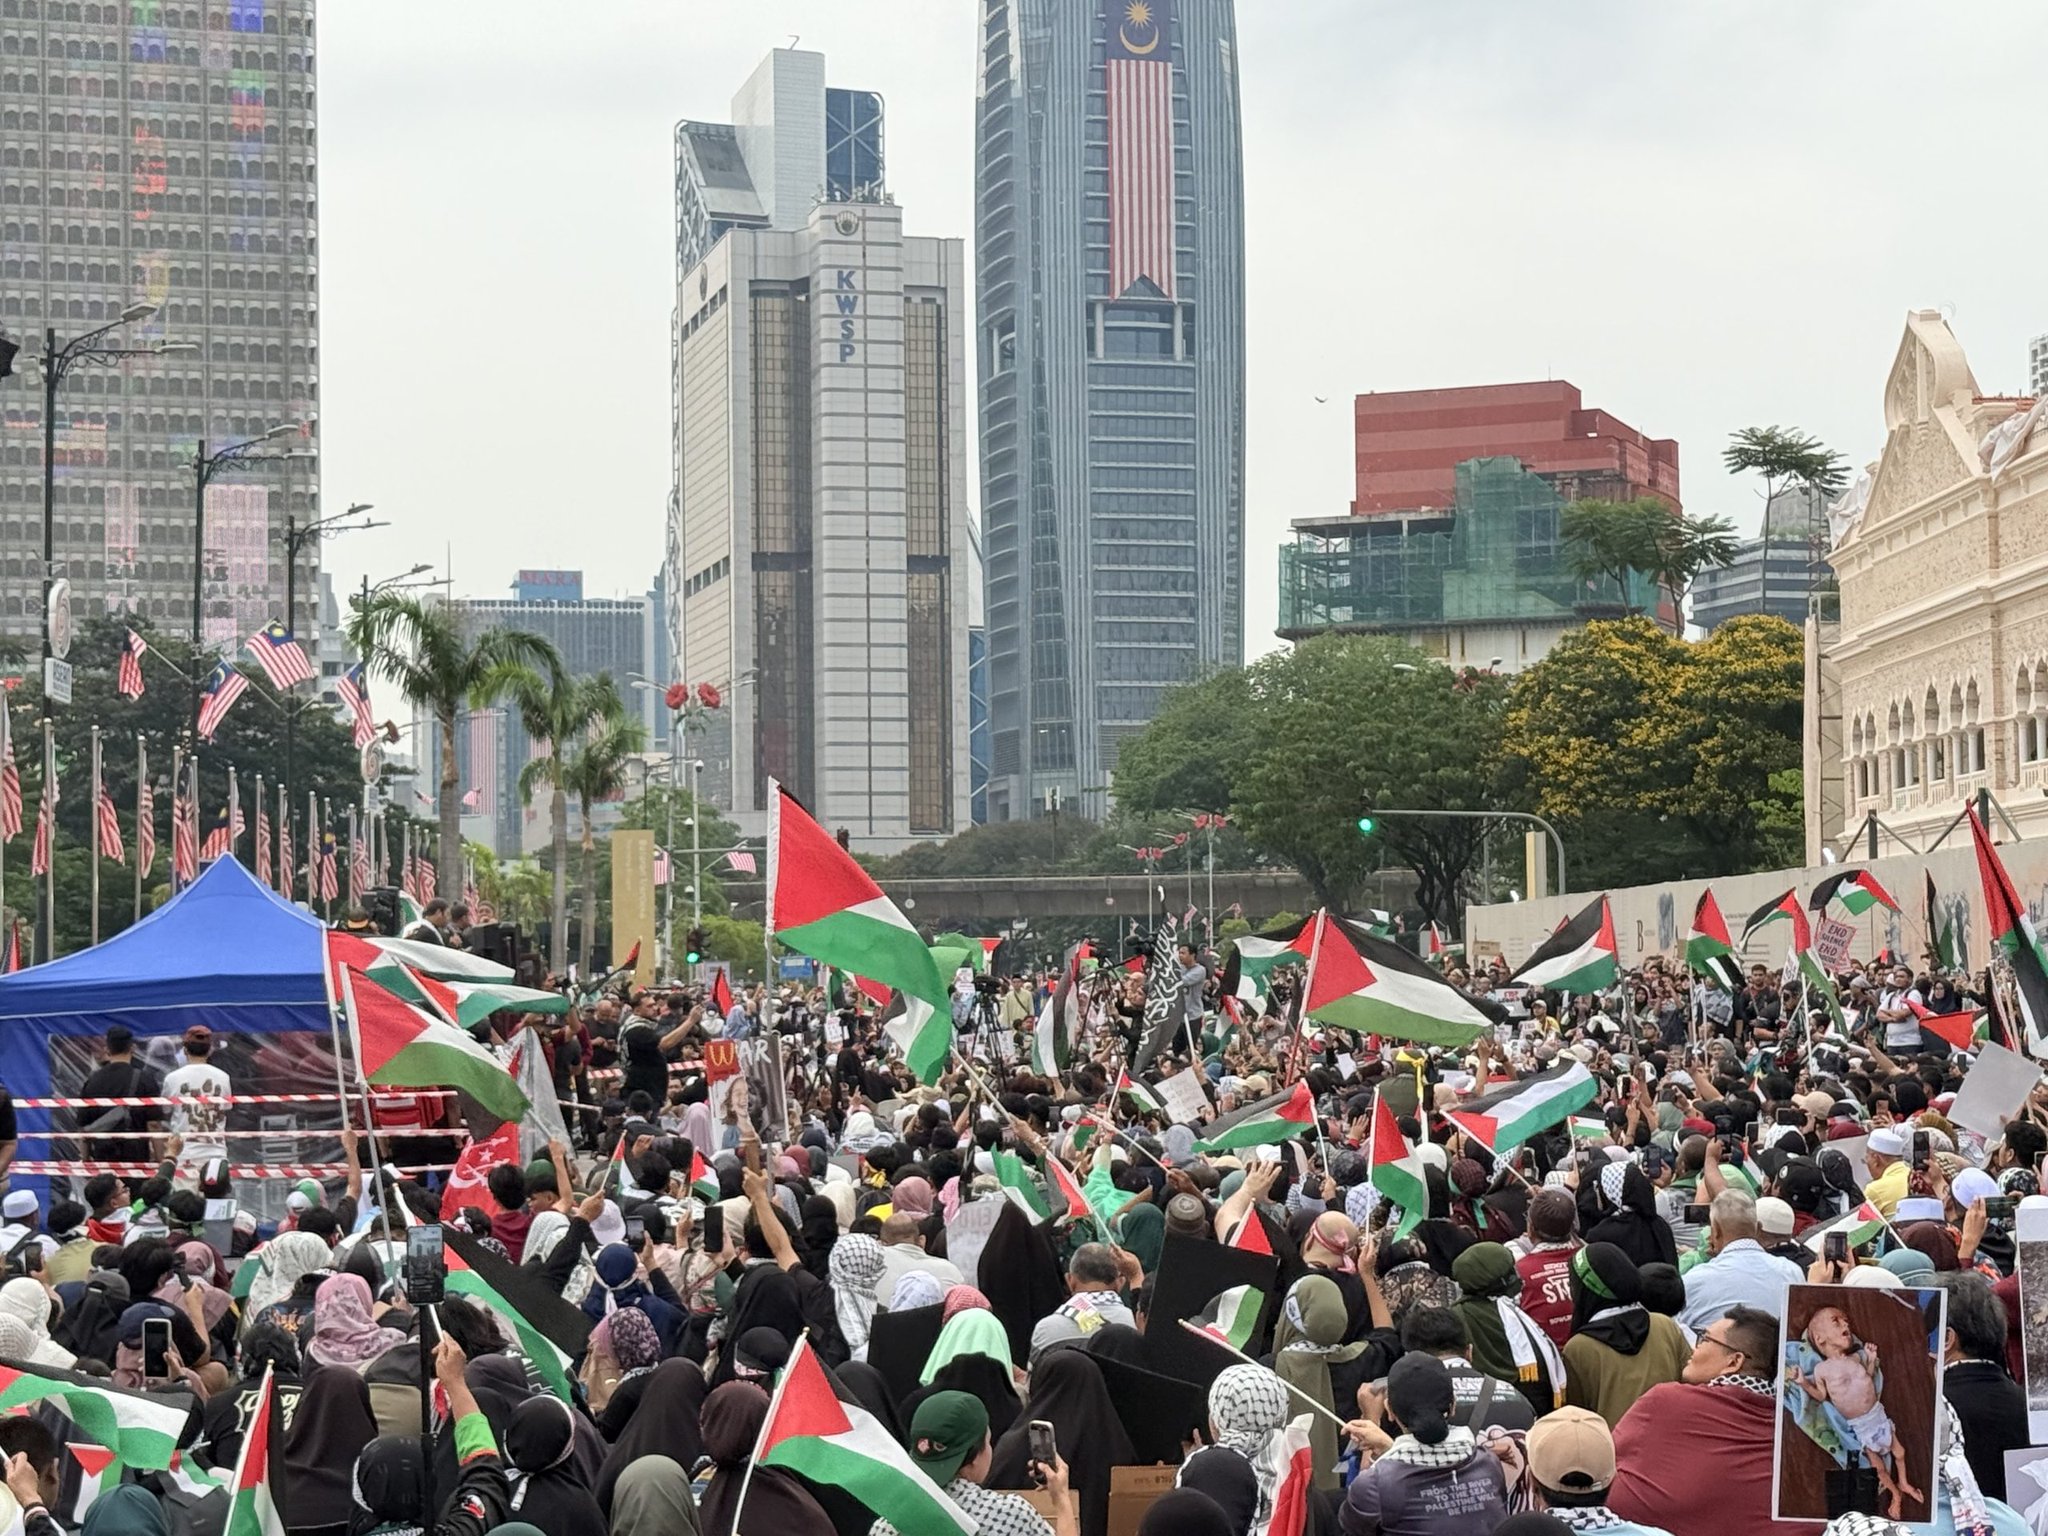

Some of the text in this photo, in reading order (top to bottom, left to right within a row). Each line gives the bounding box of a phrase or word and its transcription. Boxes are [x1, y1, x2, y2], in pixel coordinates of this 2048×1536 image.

[835, 270, 859, 362] KWSP
[1828, 924, 1847, 938] END
[1818, 943, 1838, 956] END
[1420, 1478, 1492, 1498] FROM THE RIVER
[1435, 1486, 1487, 1502] TO THE SEA
[1425, 1492, 1497, 1513] PALESTINE WILL
[1447, 1503, 1485, 1517] BE FREE
